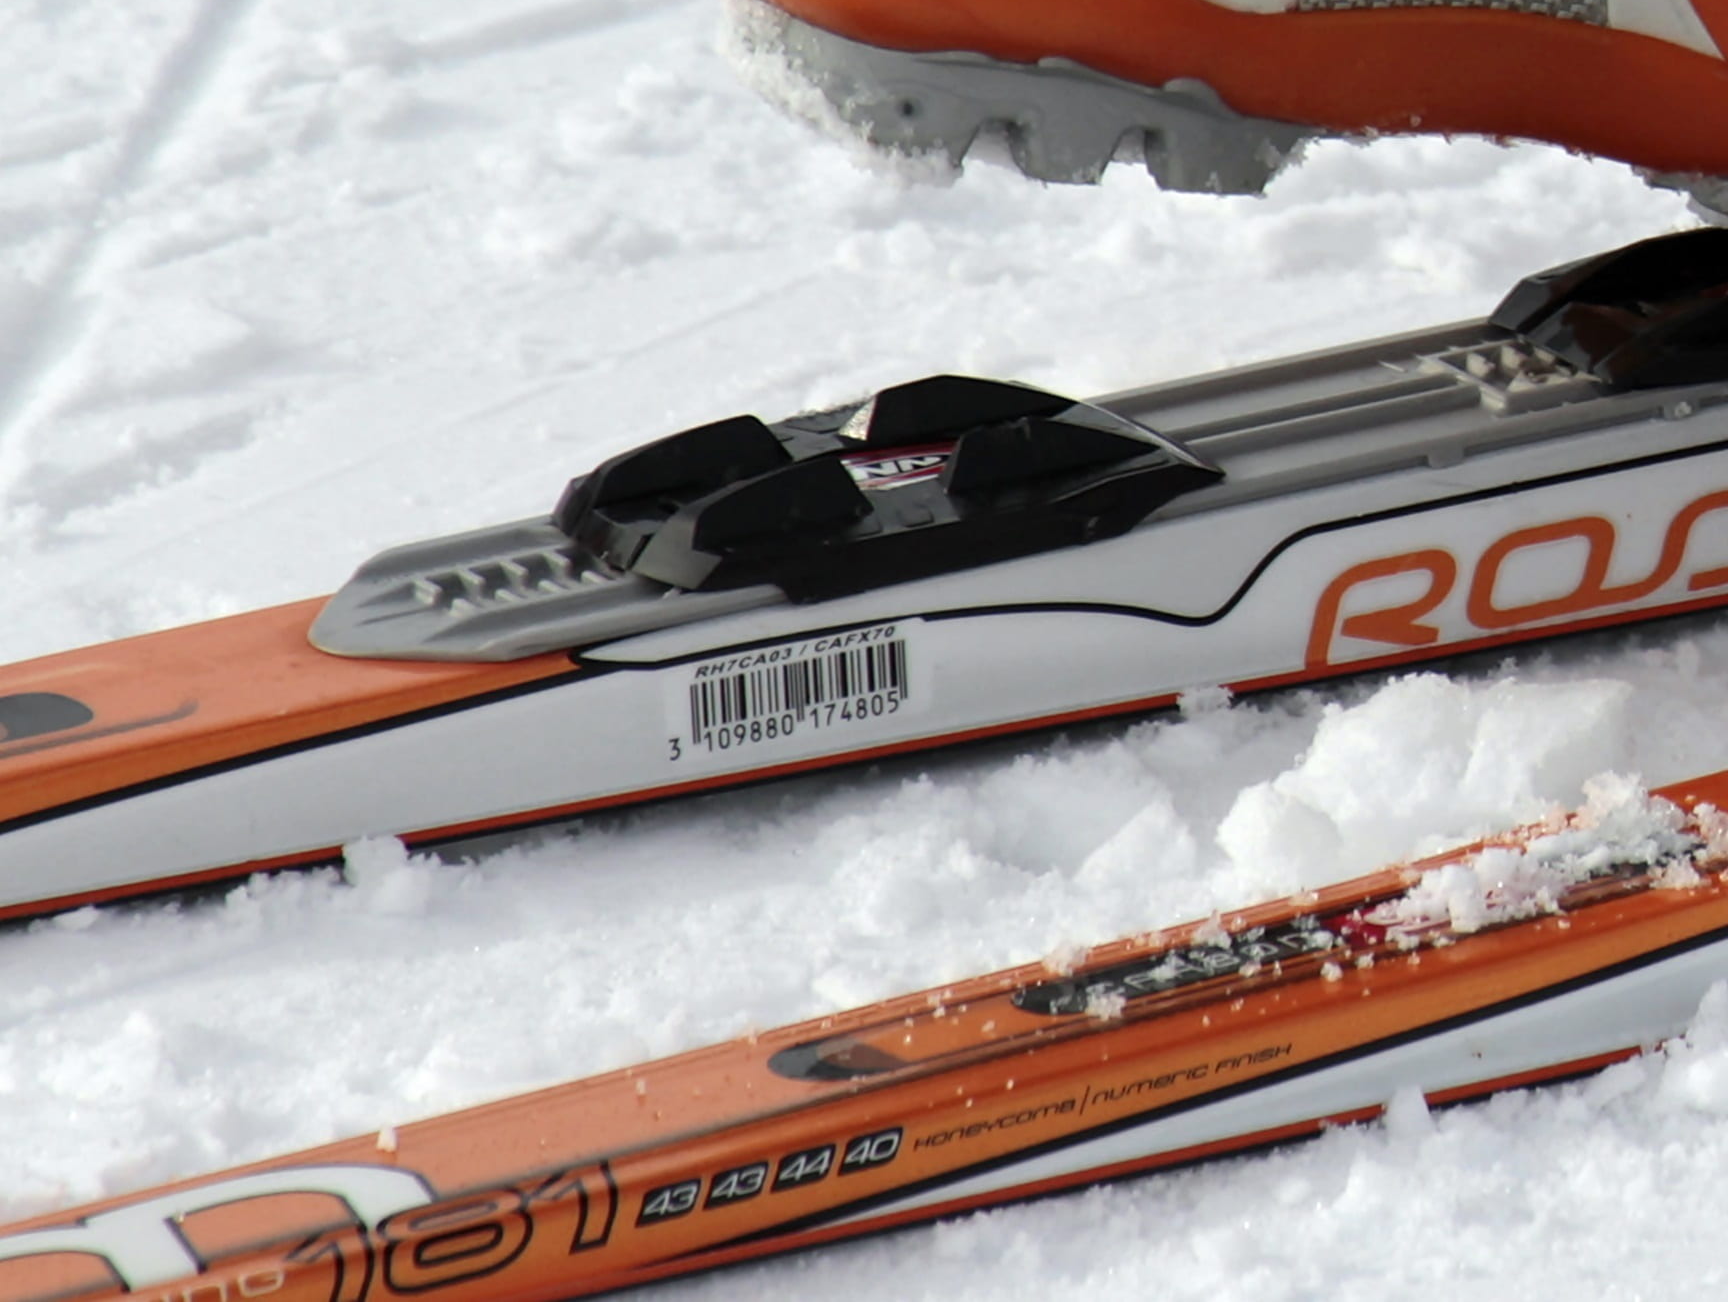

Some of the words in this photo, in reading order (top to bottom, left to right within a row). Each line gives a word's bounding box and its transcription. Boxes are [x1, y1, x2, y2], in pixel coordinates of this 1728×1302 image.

[695, 647, 792, 678] RH7CA03
[814, 625, 896, 653] CAFX70
[668, 737, 681, 761] 3
[704, 713, 795, 752] 109880
[810, 691, 899, 729] 174805
[643, 1183, 697, 1216] 43
[711, 1166, 766, 1199] 43
[778, 1147, 831, 1182] 44
[844, 1131, 899, 1165] 40
